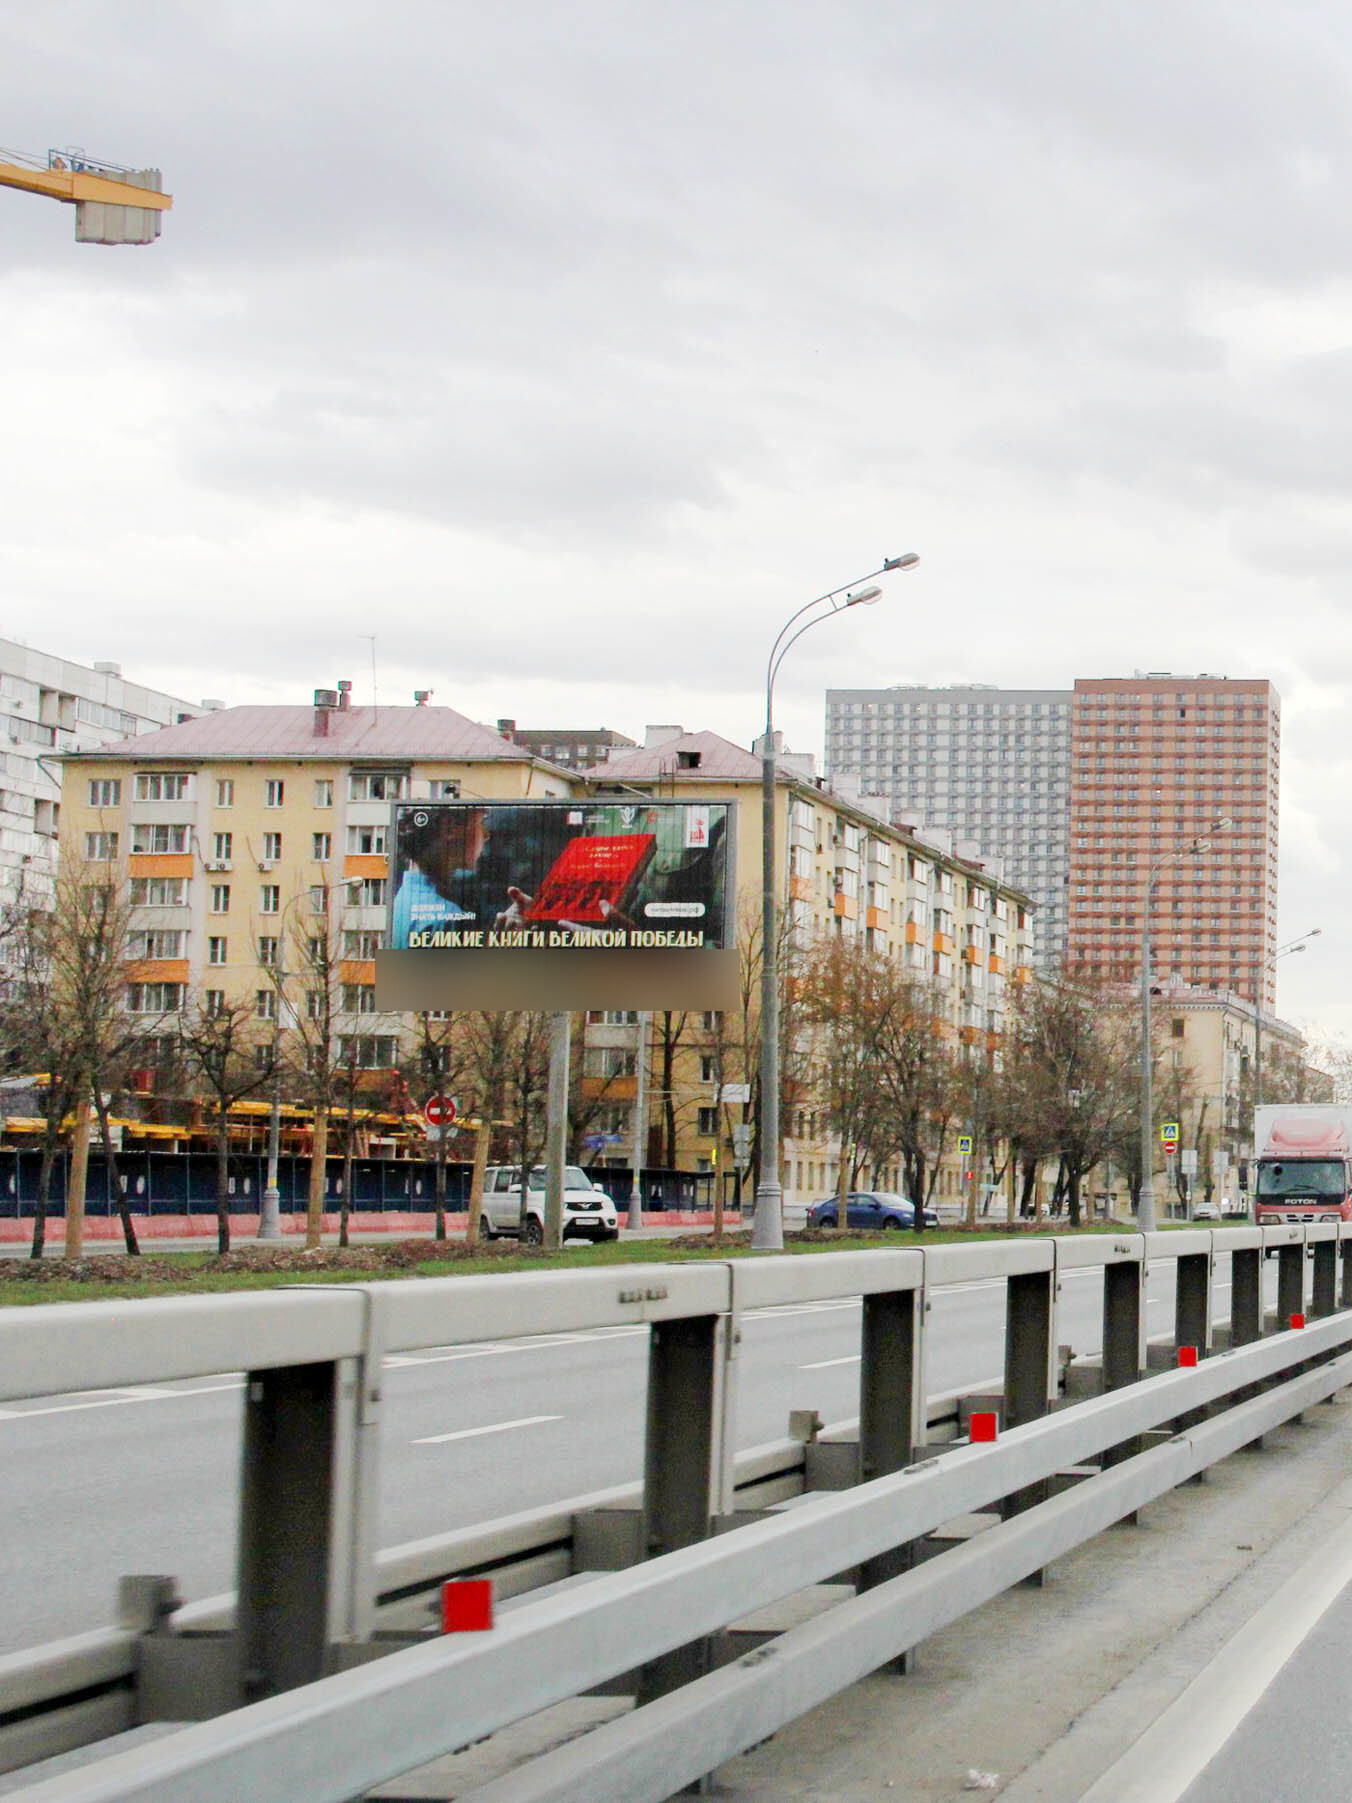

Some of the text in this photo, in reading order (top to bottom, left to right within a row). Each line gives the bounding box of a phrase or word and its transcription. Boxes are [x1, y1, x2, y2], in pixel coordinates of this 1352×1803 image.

[409, 928, 704, 948] ВЕЛИКИЕ КНИГИ ВЕЛИКОЙ ПОБЕДЫ
